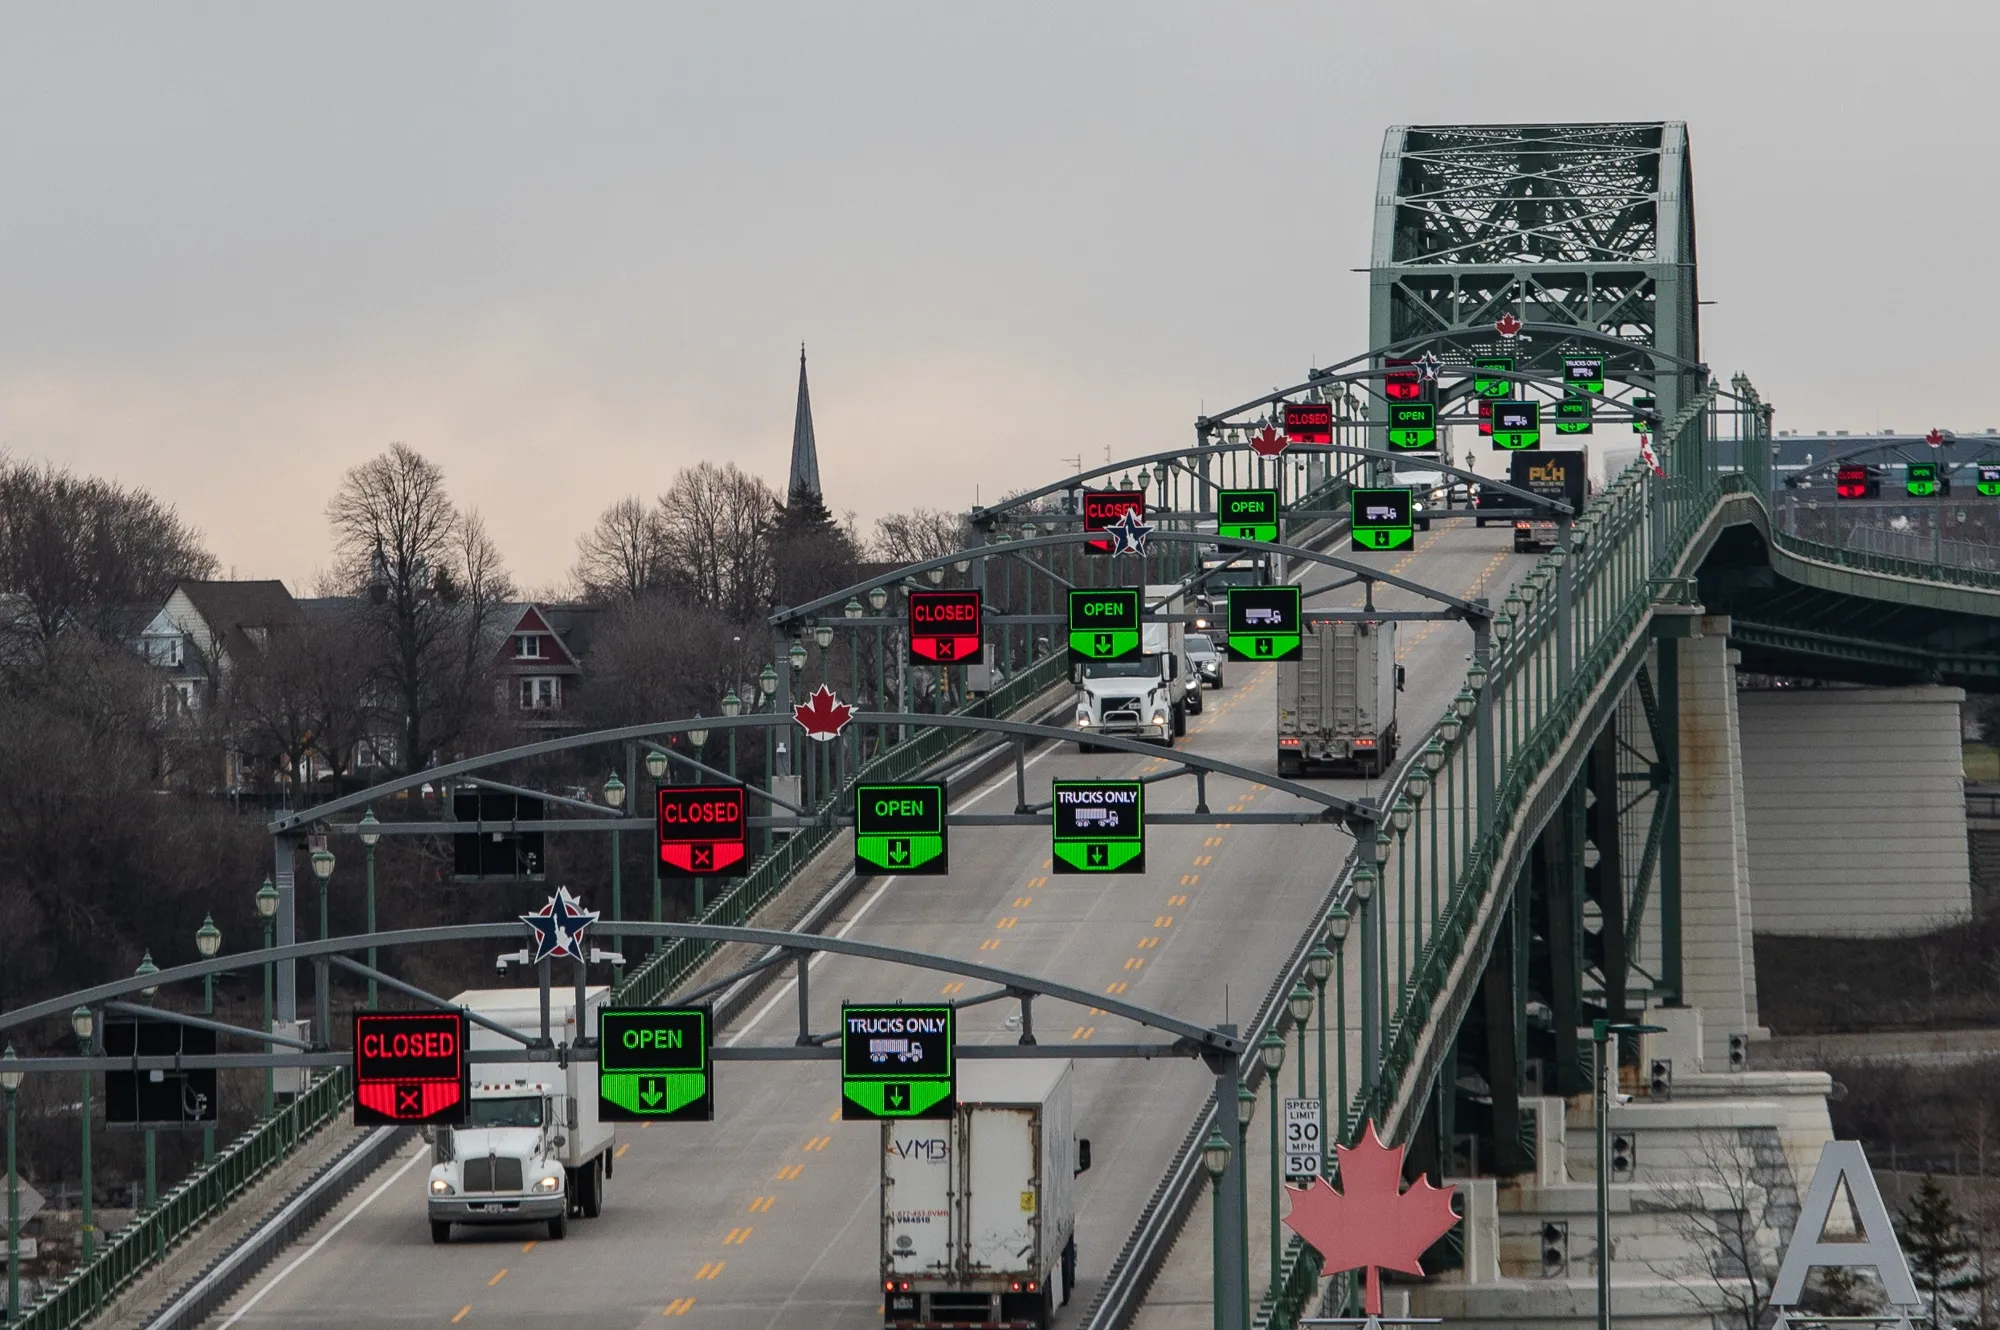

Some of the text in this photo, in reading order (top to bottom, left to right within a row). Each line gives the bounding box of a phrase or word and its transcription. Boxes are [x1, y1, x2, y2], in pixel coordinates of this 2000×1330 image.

[1288, 413, 1328, 424] CLOSED
[1399, 411, 1425, 420] OPEN
[1529, 467, 1565, 480] PLH
[1231, 501, 1265, 514] OPEN
[915, 602, 975, 622] CLOSED
[1084, 603, 1124, 617] OPEN
[1057, 789, 1138, 805] TRUCKS ONLY
[664, 801, 739, 823] CLOSED
[874, 800, 924, 817] OPEN
[849, 1016, 946, 1034] TRUCKS ONLY
[363, 1032, 454, 1058] CLOSED
[622, 1028, 684, 1050] OPEN
[1286, 1101, 1320, 1110] SPEED
[1290, 1111, 1316, 1120] LIMIT
[1288, 1123, 1319, 1141] 30
[895, 1139, 947, 1160] VMB
[1292, 1143, 1315, 1151] MPH
[1290, 1156, 1317, 1172] 50
[1769, 1140, 1922, 1306] A
